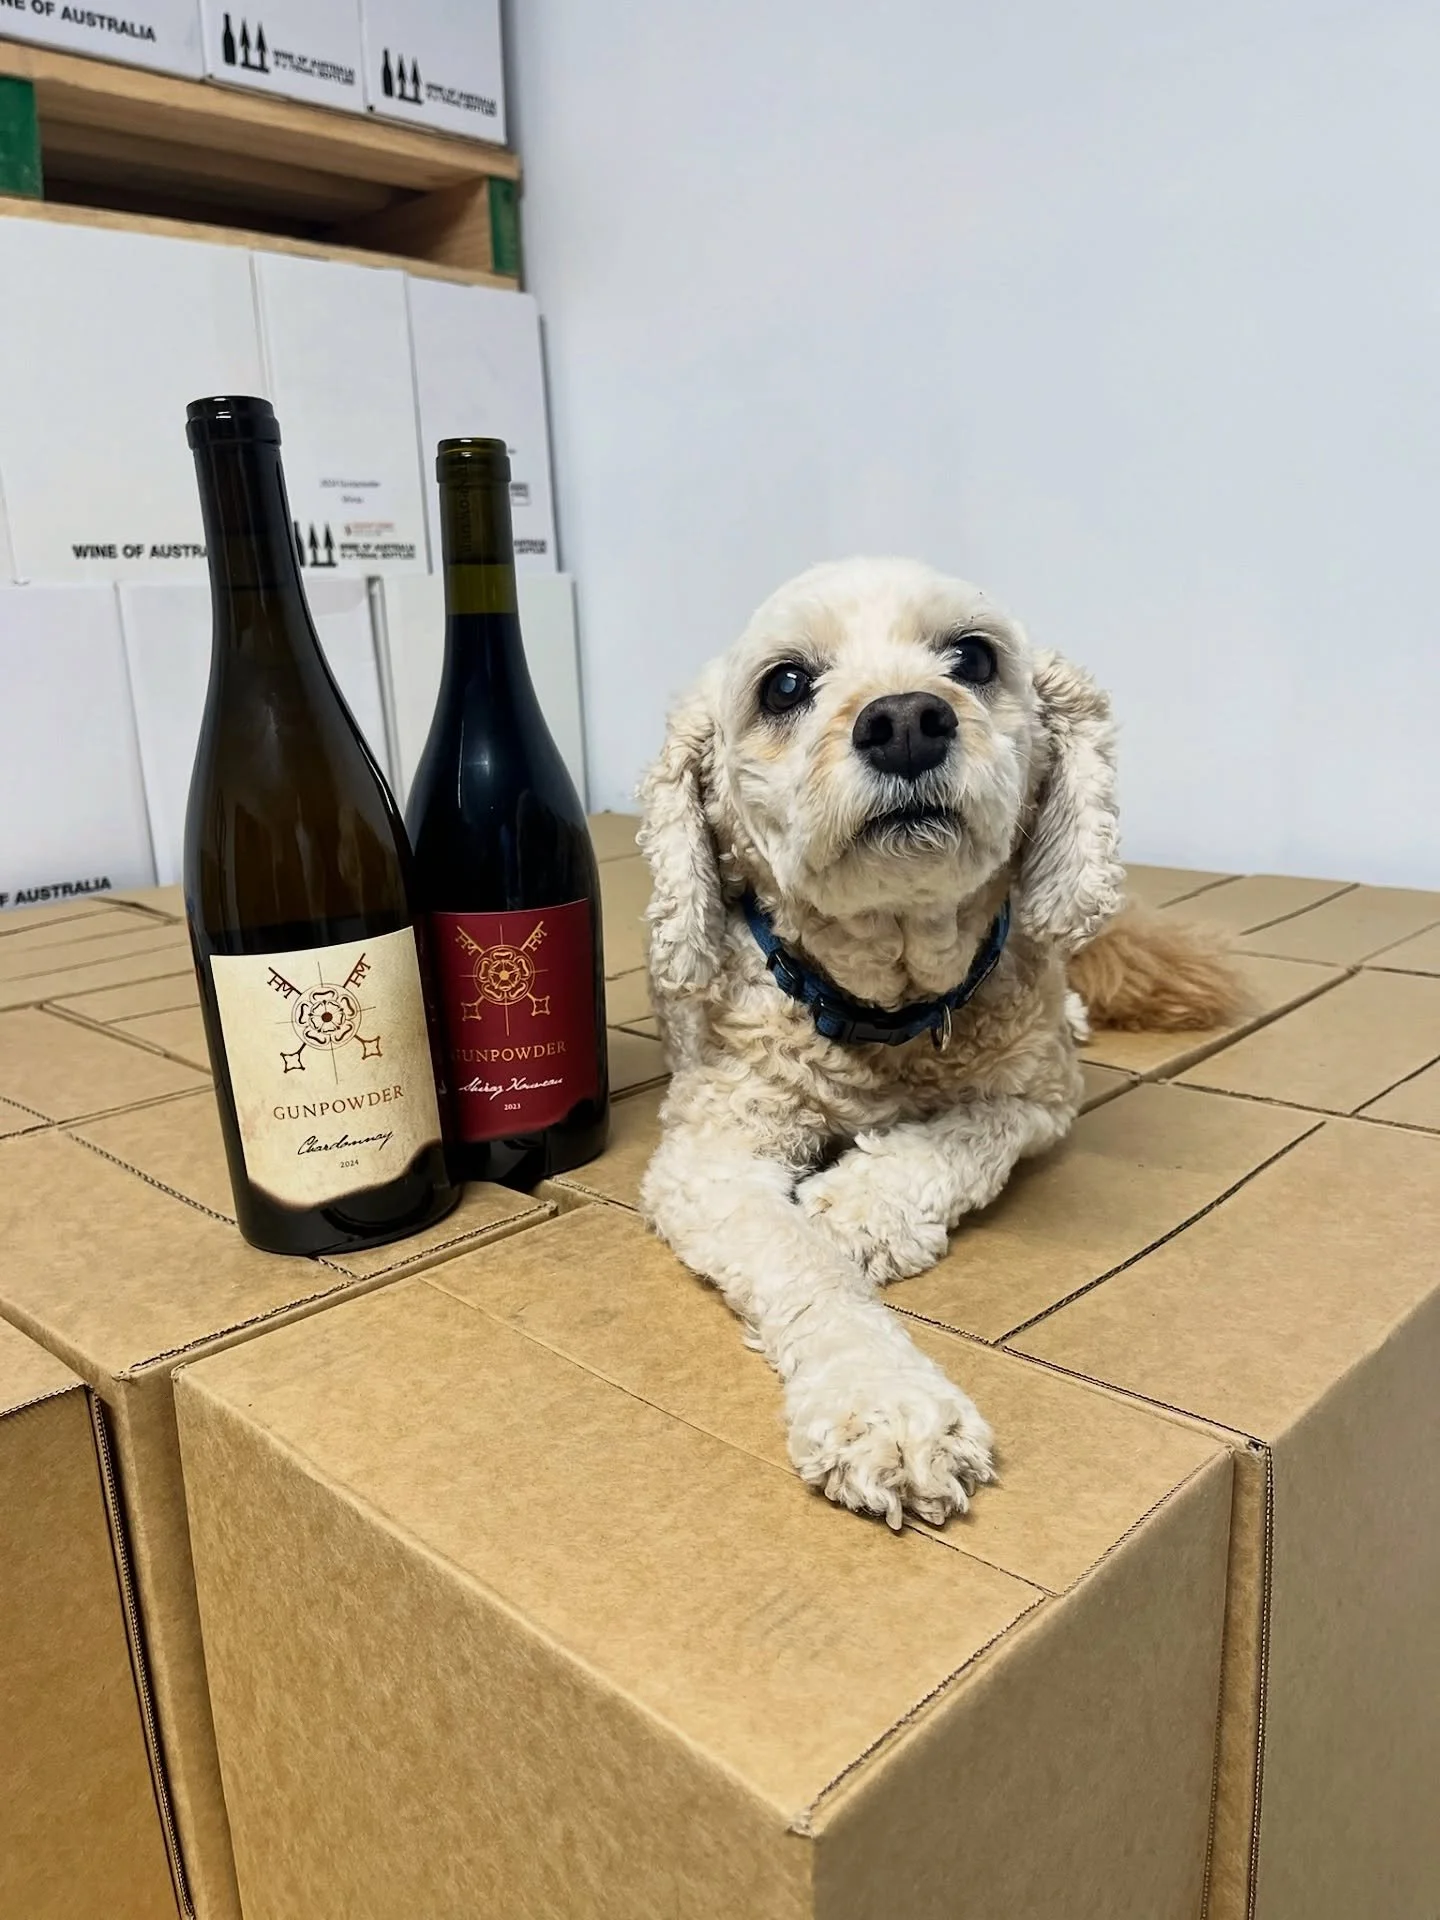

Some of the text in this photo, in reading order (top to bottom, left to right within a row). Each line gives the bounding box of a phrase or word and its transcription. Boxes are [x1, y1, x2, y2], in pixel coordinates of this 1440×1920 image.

[0, 0, 156, 42] NE OF AUSTRALIA
[72, 544, 118, 559] WINE
[122, 544, 144, 558] OF
[0, 876, 112, 908] F AUSTRALIA
[458, 1077, 503, 1101] Shiraz
[273, 1085, 404, 1120] GUNPOWDER
[503, 1103, 521, 1111] 2023
[297, 1131, 394, 1155] Chardonnay
[340, 1159, 360, 1168] 2024
